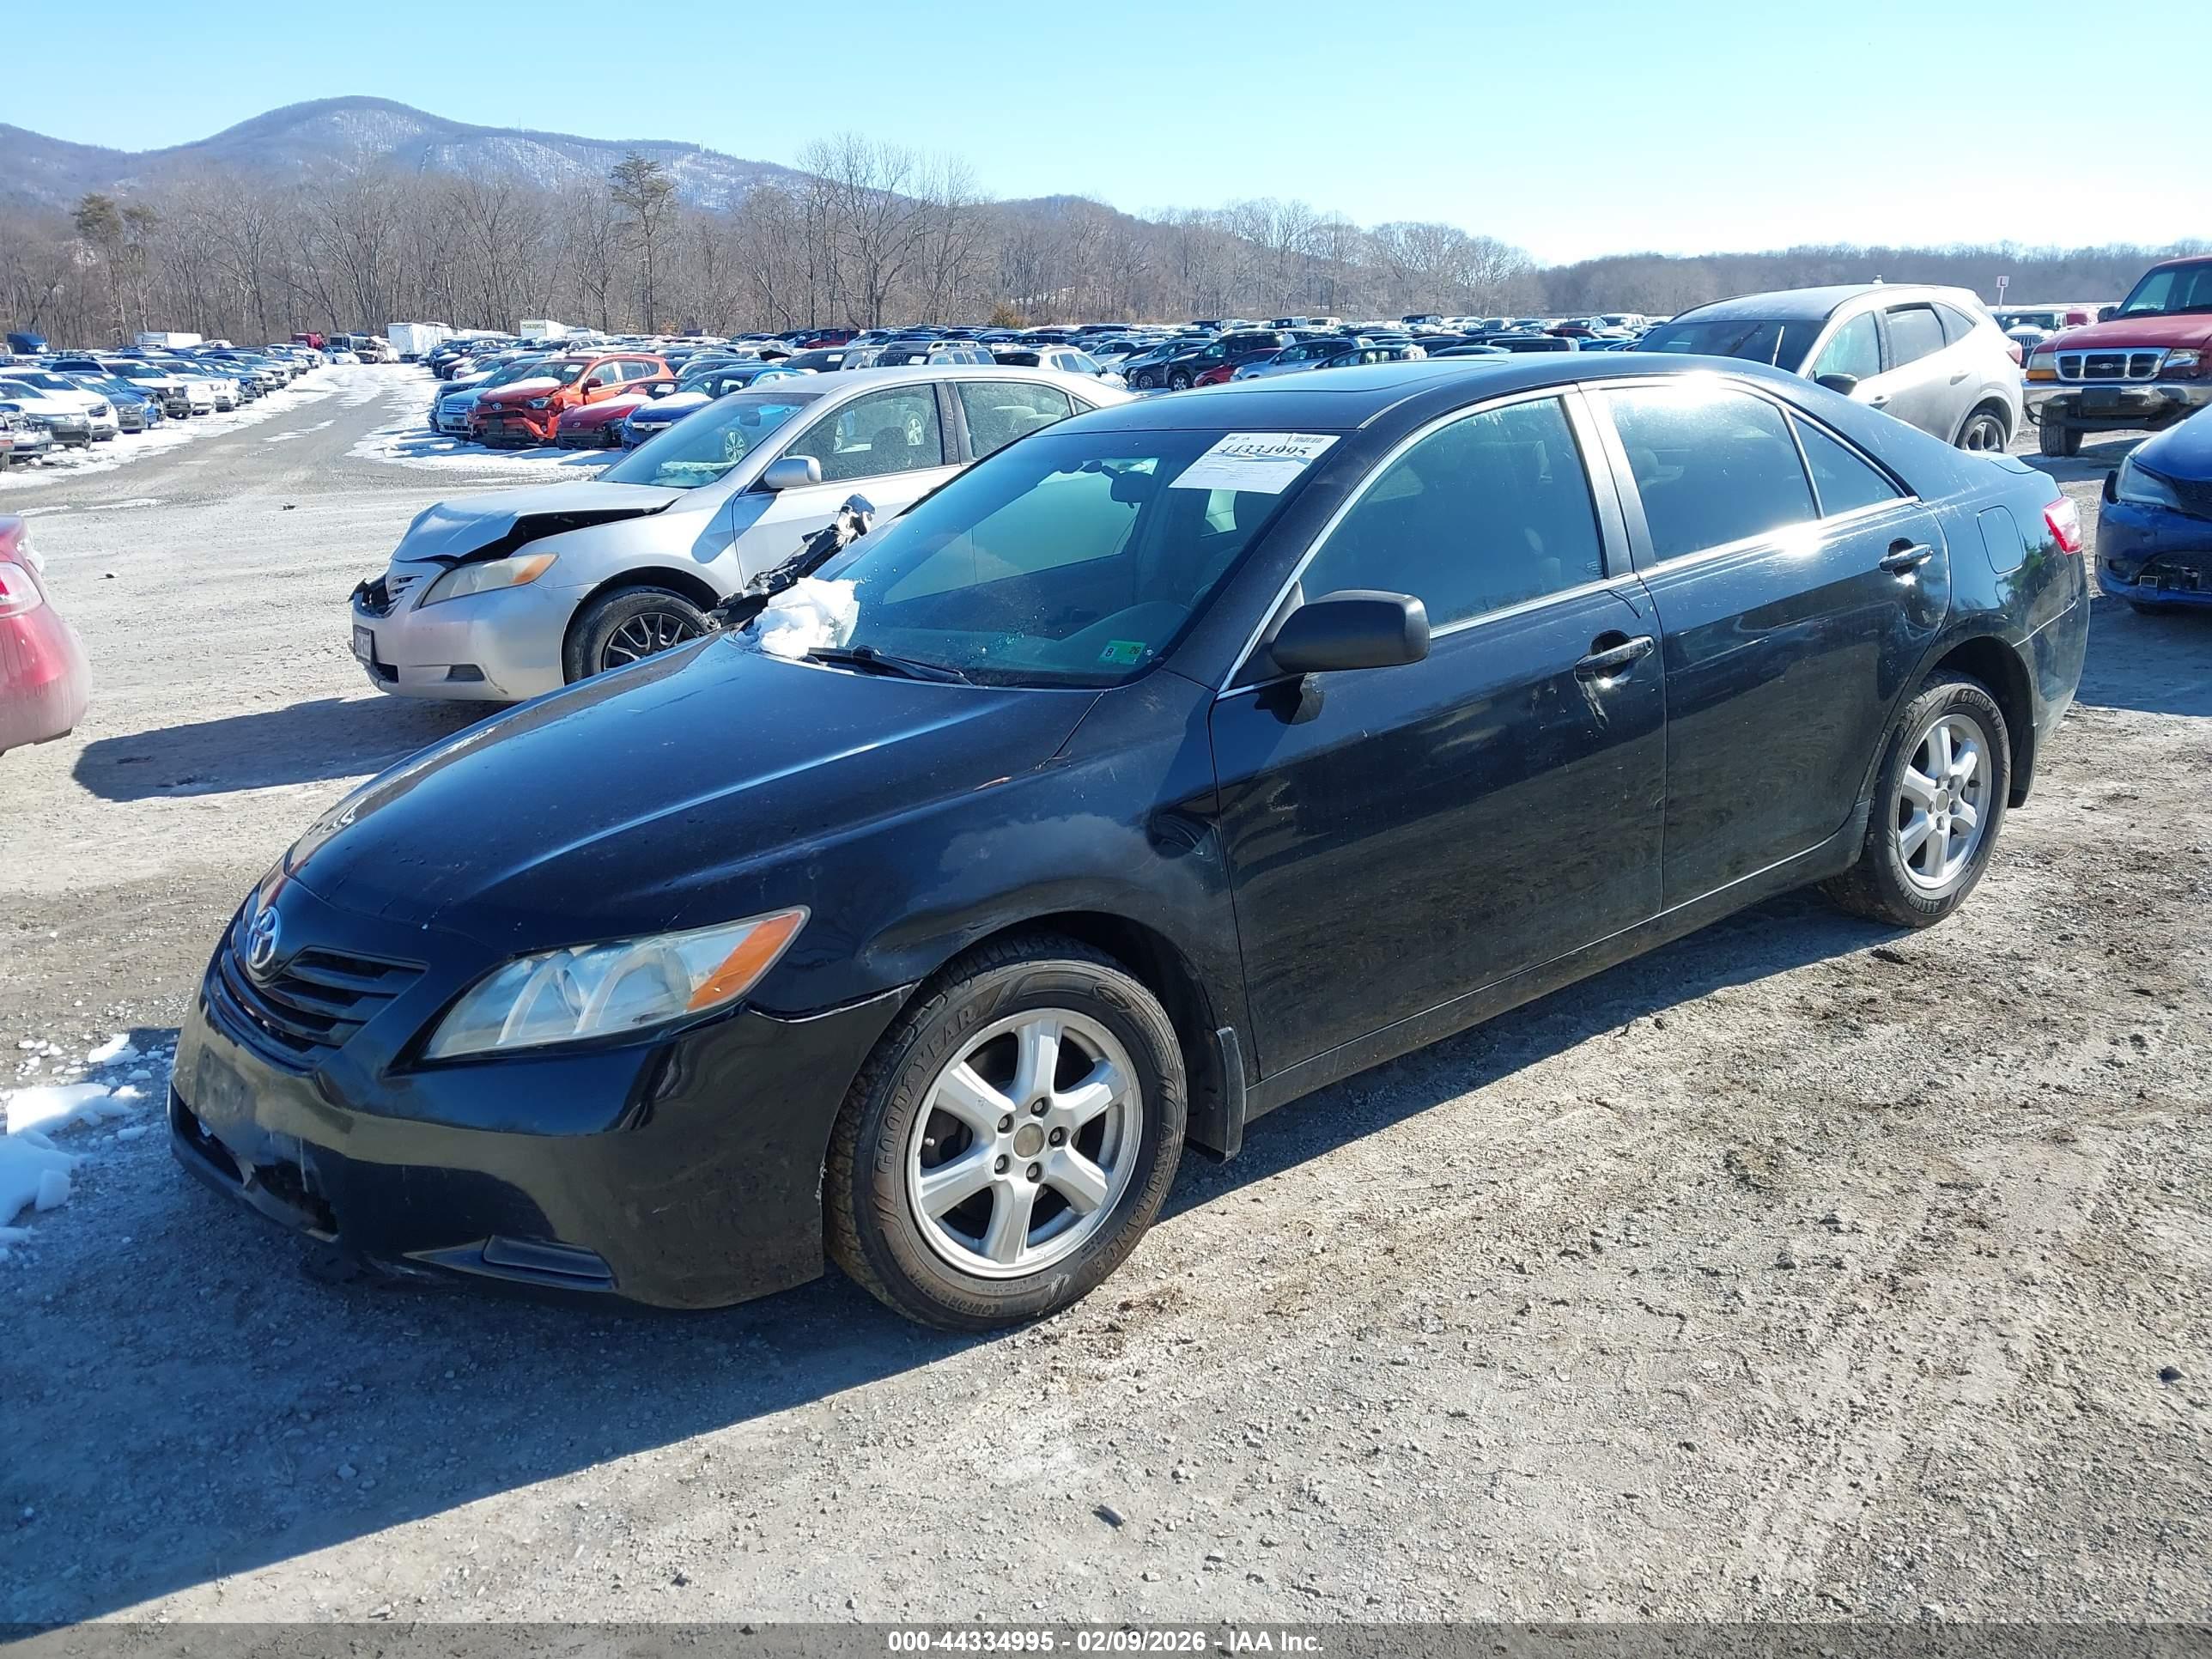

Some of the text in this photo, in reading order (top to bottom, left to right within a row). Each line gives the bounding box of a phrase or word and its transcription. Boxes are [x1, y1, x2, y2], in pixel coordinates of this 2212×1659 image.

[1219, 444, 1311, 457] 44334995
[1105, 647, 1115, 657] 8
[878, 1010, 977, 1173] GOODYEAR
